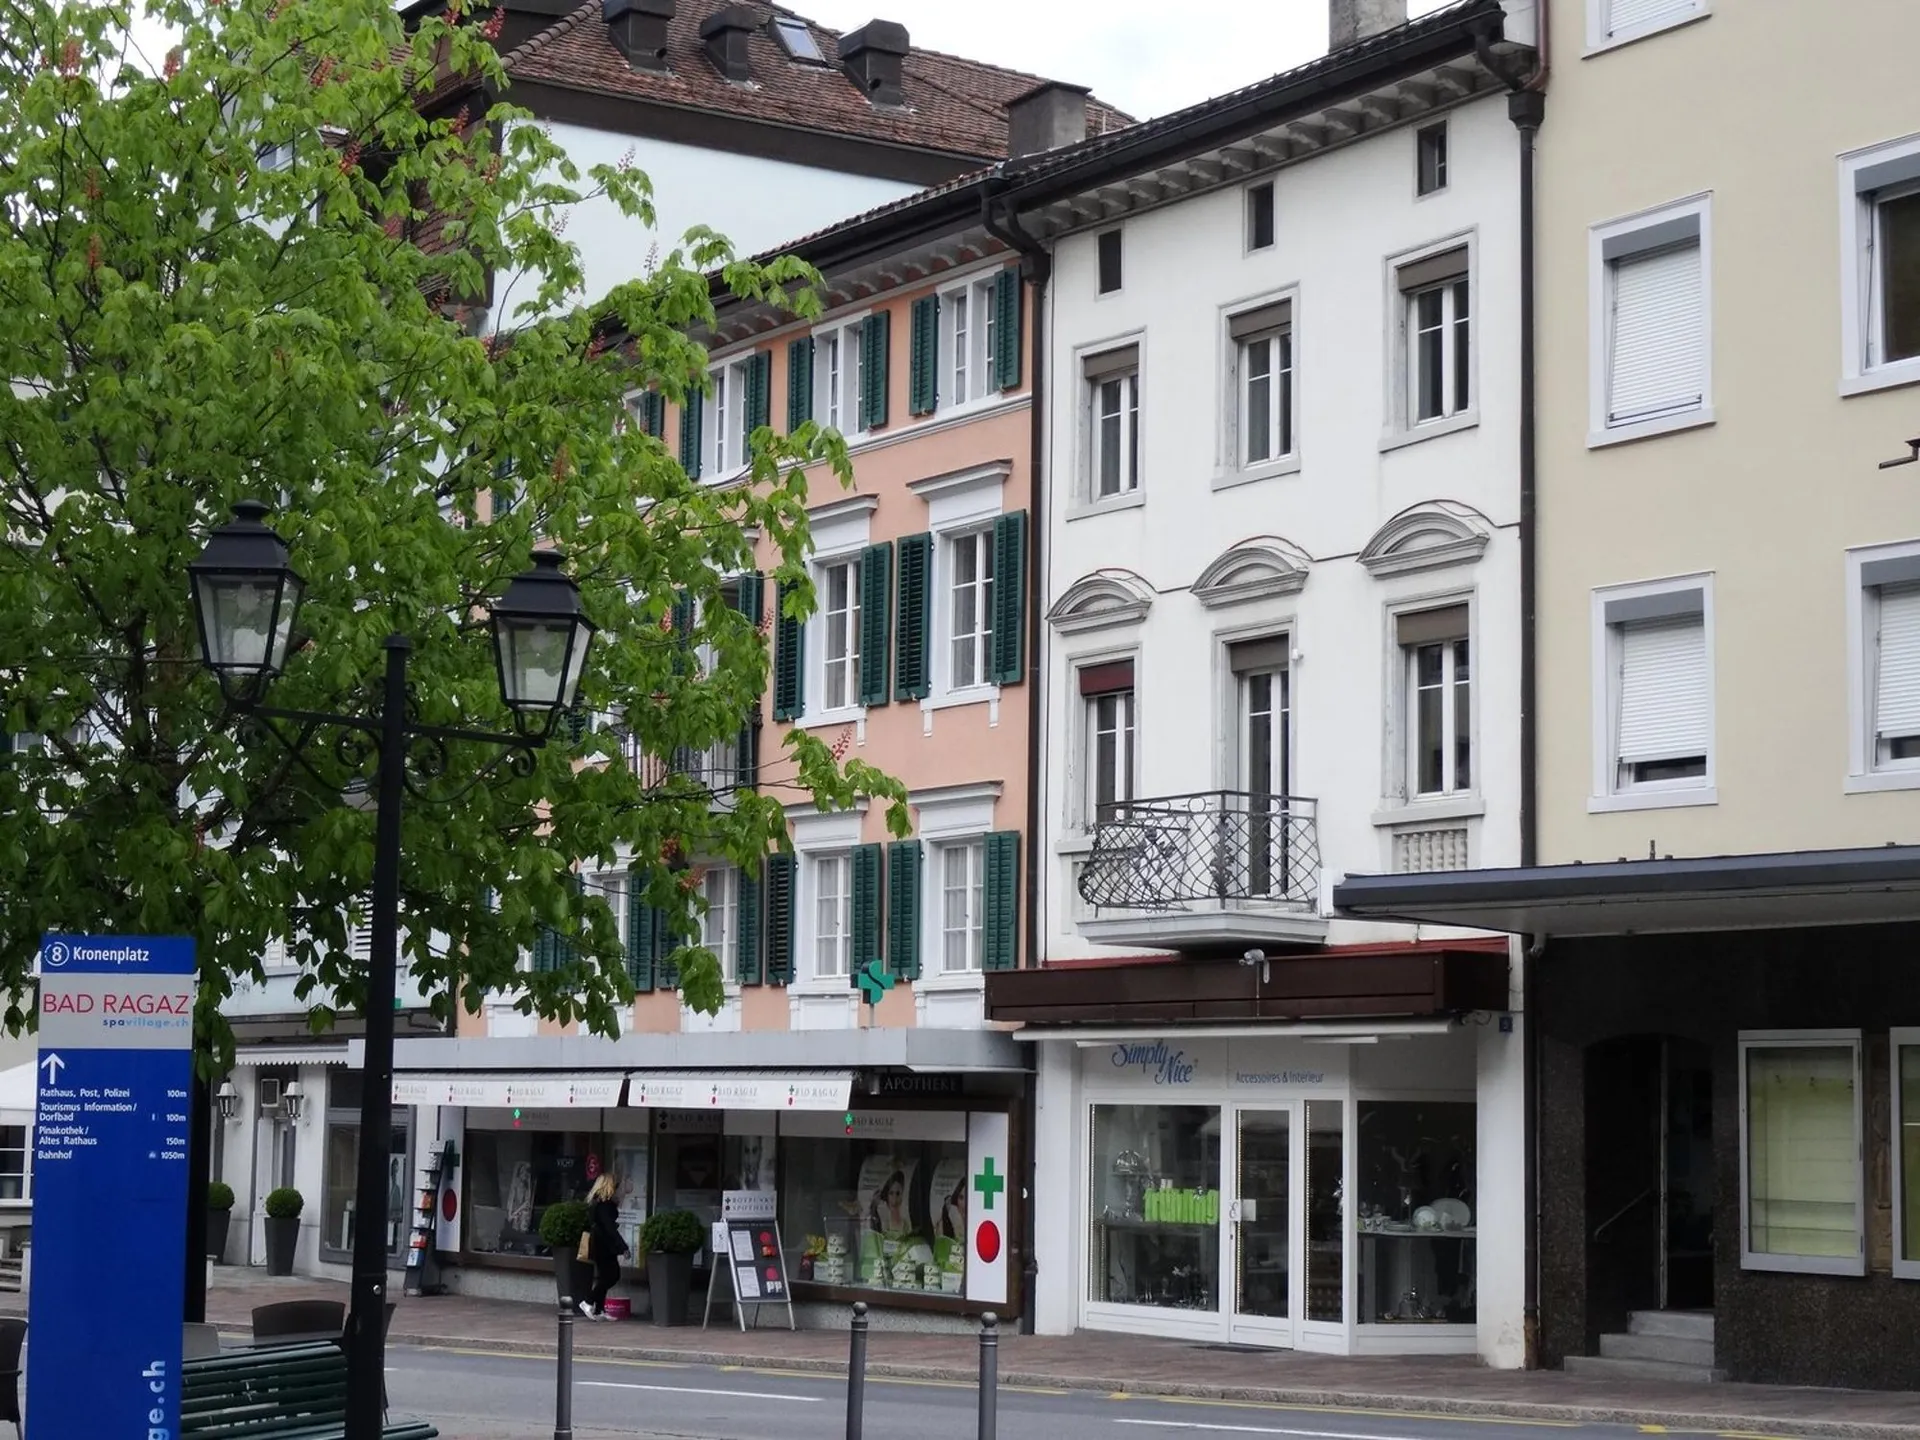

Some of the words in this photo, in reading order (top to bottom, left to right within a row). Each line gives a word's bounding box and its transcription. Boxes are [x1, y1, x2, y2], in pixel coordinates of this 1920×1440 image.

[51, 946, 62, 962] 8
[73, 946, 149, 964] Kronenplatz
[43, 994, 94, 1013] BAD
[103, 994, 189, 1014] RAGAZ
[103, 1017, 189, 1028] spavillage.ch
[1111, 1038, 1168, 1073] Simply
[1155, 1051, 1194, 1084] Nice
[1236, 1071, 1280, 1083] Accessoires
[1282, 1071, 1288, 1083] &
[883, 1077, 957, 1091] APOTHEKE
[40, 1088, 76, 1098] Rathaus,
[80, 1088, 100, 1098] Post,
[104, 1088, 130, 1098] Polizei
[167, 1090, 187, 1098] 100m
[40, 1102, 81, 1112] Tourismus
[39, 1112, 74, 1122] Dorfbad
[166, 1113, 186, 1122] 100m
[38, 1136, 60, 1145] Altes
[63, 1136, 97, 1145] Rathaus
[166, 1137, 186, 1145] 150m
[38, 1150, 73, 1159] Bahnhof
[161, 1151, 185, 1159] 1050m
